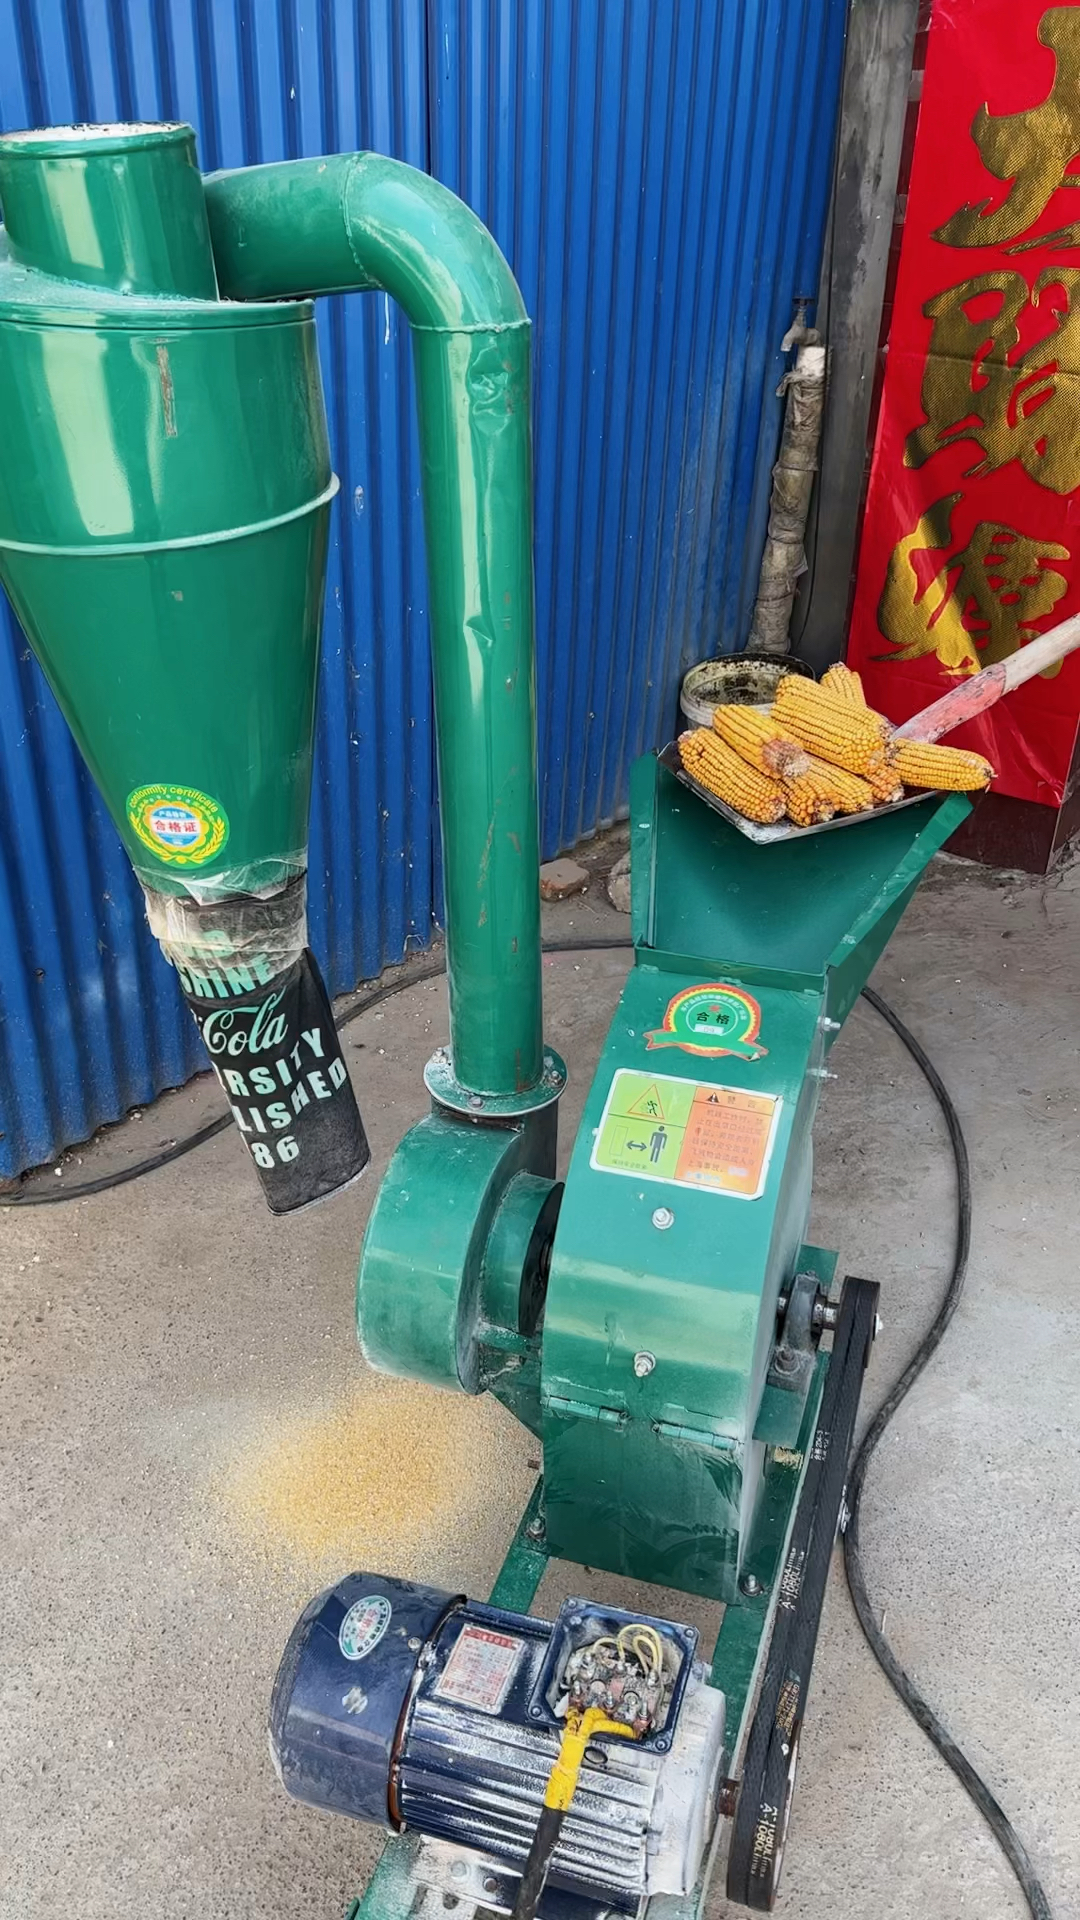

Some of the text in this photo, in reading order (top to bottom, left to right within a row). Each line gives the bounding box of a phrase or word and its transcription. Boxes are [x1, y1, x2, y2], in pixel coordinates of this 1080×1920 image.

[169, 786, 219, 813] certificate
[154, 819, 198, 833] 合格证
[696, 1011, 731, 1025] 合格
[212, 1027, 325, 1097] RSITY
